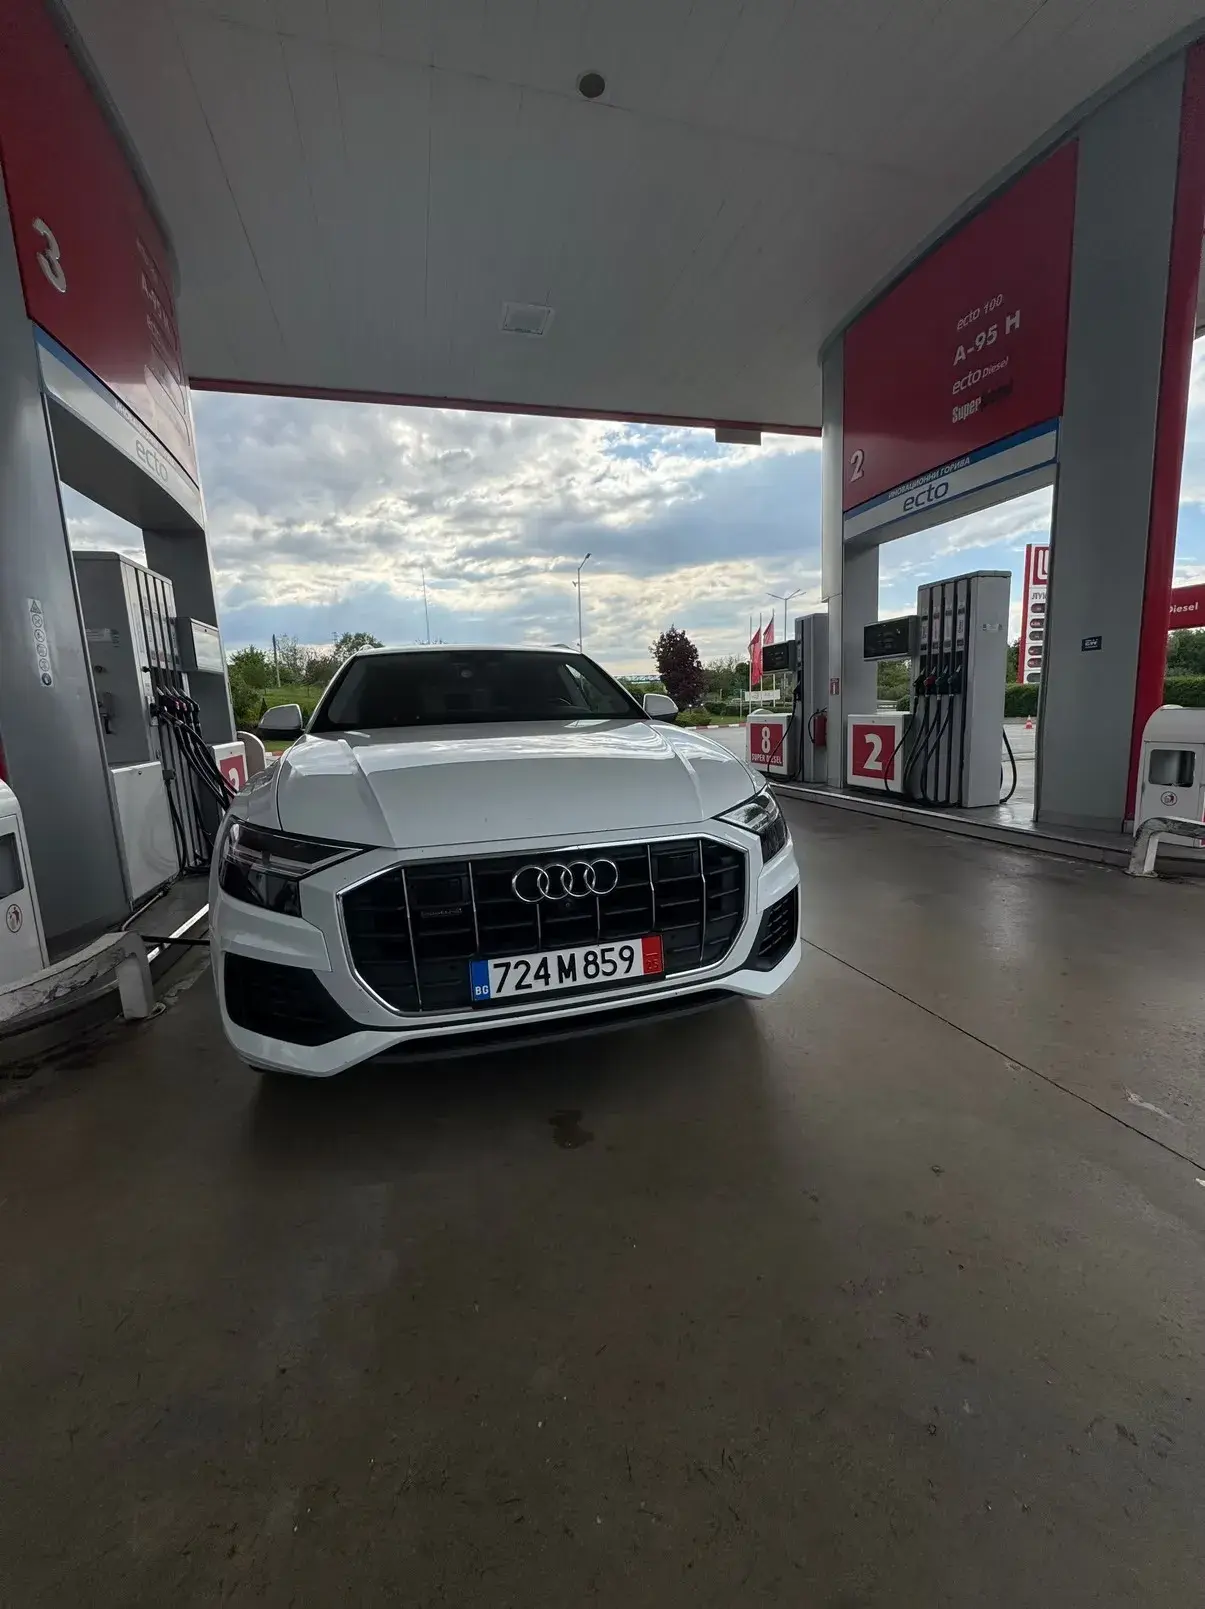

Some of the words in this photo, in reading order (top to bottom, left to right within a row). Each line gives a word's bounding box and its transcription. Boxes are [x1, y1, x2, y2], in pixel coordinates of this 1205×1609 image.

[32, 217, 67, 293] 3
[957, 307, 981, 330] ecto
[984, 294, 1003, 314] 100
[953, 324, 998, 366] A-95
[1005, 310, 1020, 335] H
[952, 368, 982, 395] ecto
[982, 356, 1009, 378] Diesel
[952, 397, 982, 424] Super
[136, 439, 168, 482] ecto
[849, 449, 865, 483] 2
[940, 457, 970, 476] ГОРИВА
[903, 481, 949, 512] ecto
[751, 753, 764, 761] SUPER
[761, 726, 771, 754] 8
[863, 733, 883, 771] 2
[493, 957, 551, 993] 724
[557, 953, 577, 984] M
[583, 945, 635, 980] 859
[475, 985, 489, 995] BG
